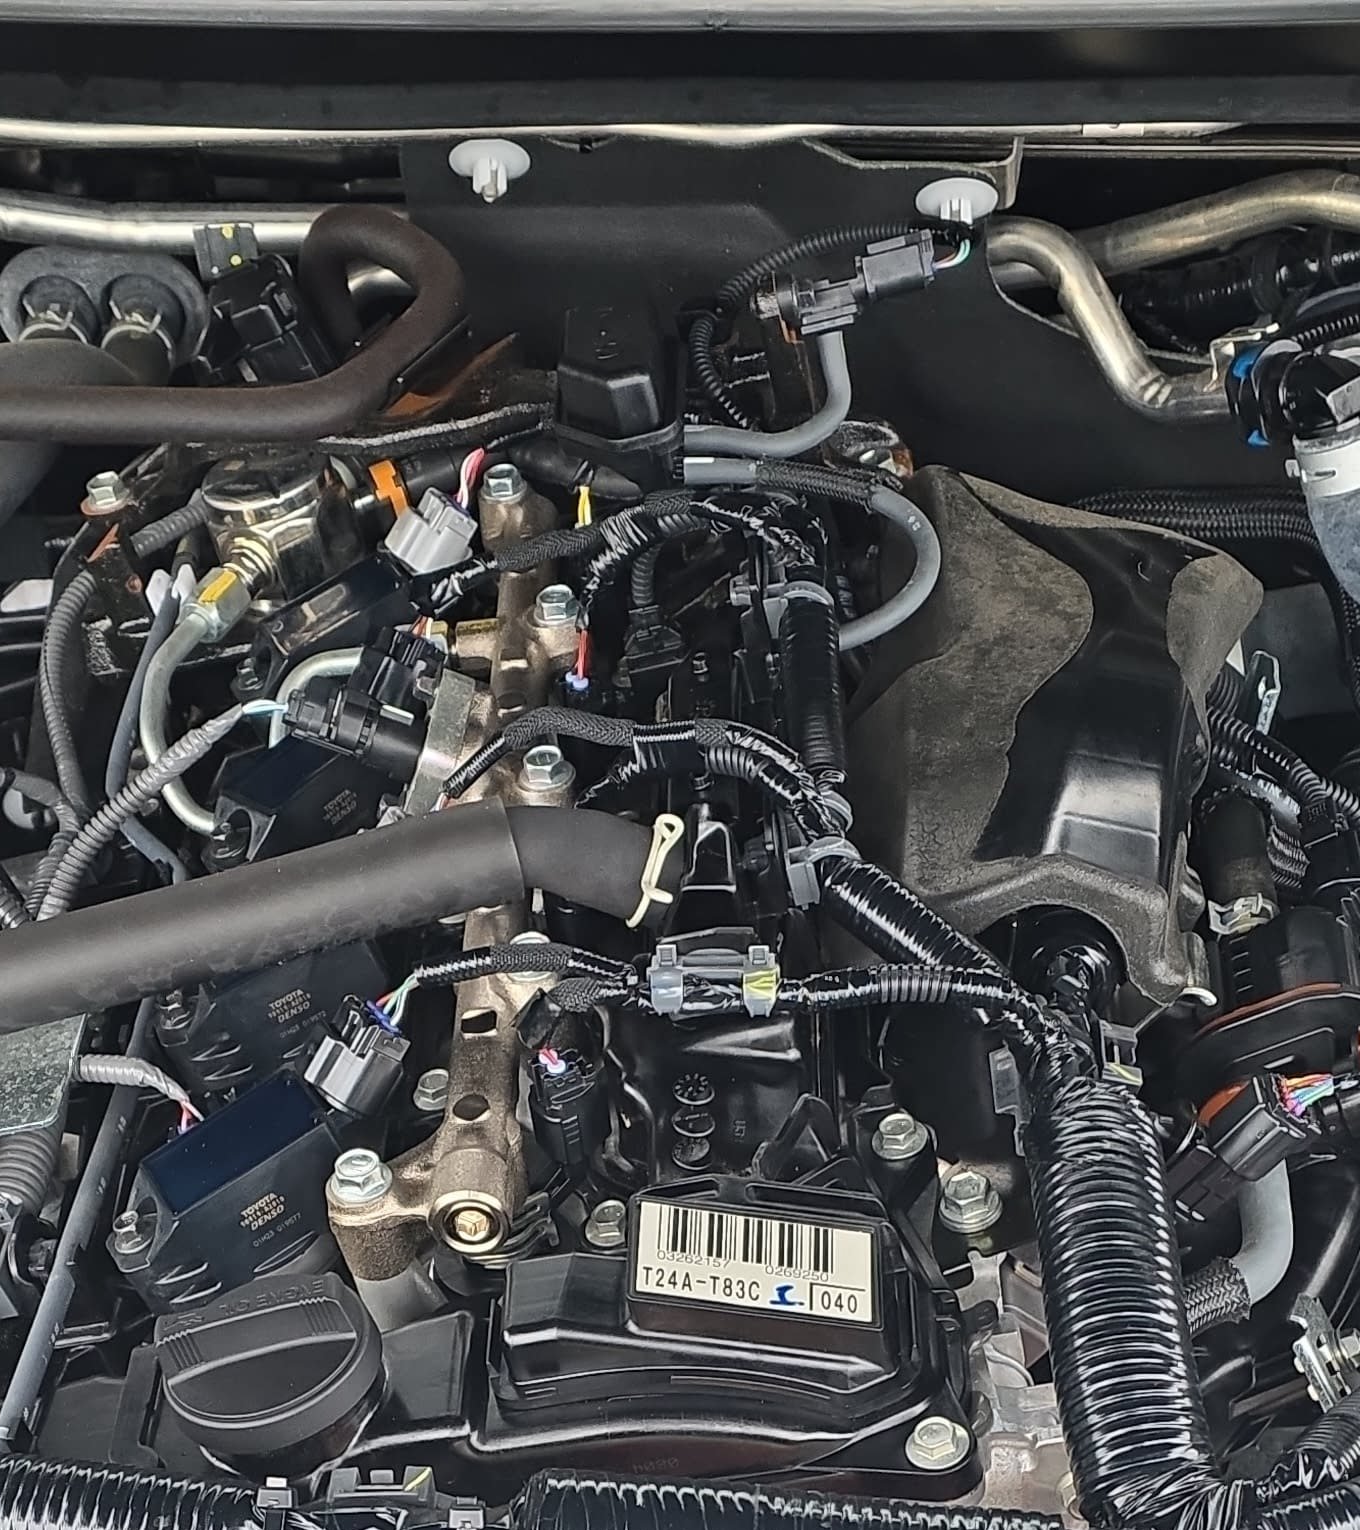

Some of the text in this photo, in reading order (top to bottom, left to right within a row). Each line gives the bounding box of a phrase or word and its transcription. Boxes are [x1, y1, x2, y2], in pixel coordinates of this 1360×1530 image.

[269, 989, 304, 1009] TOYOTA
[278, 1001, 310, 1023] DENSO
[241, 1193, 278, 1217] TOYOTA
[251, 1205, 284, 1231] DENSO
[643, 1266, 760, 1301] T24A-T83C
[821, 1290, 858, 1313] 040
